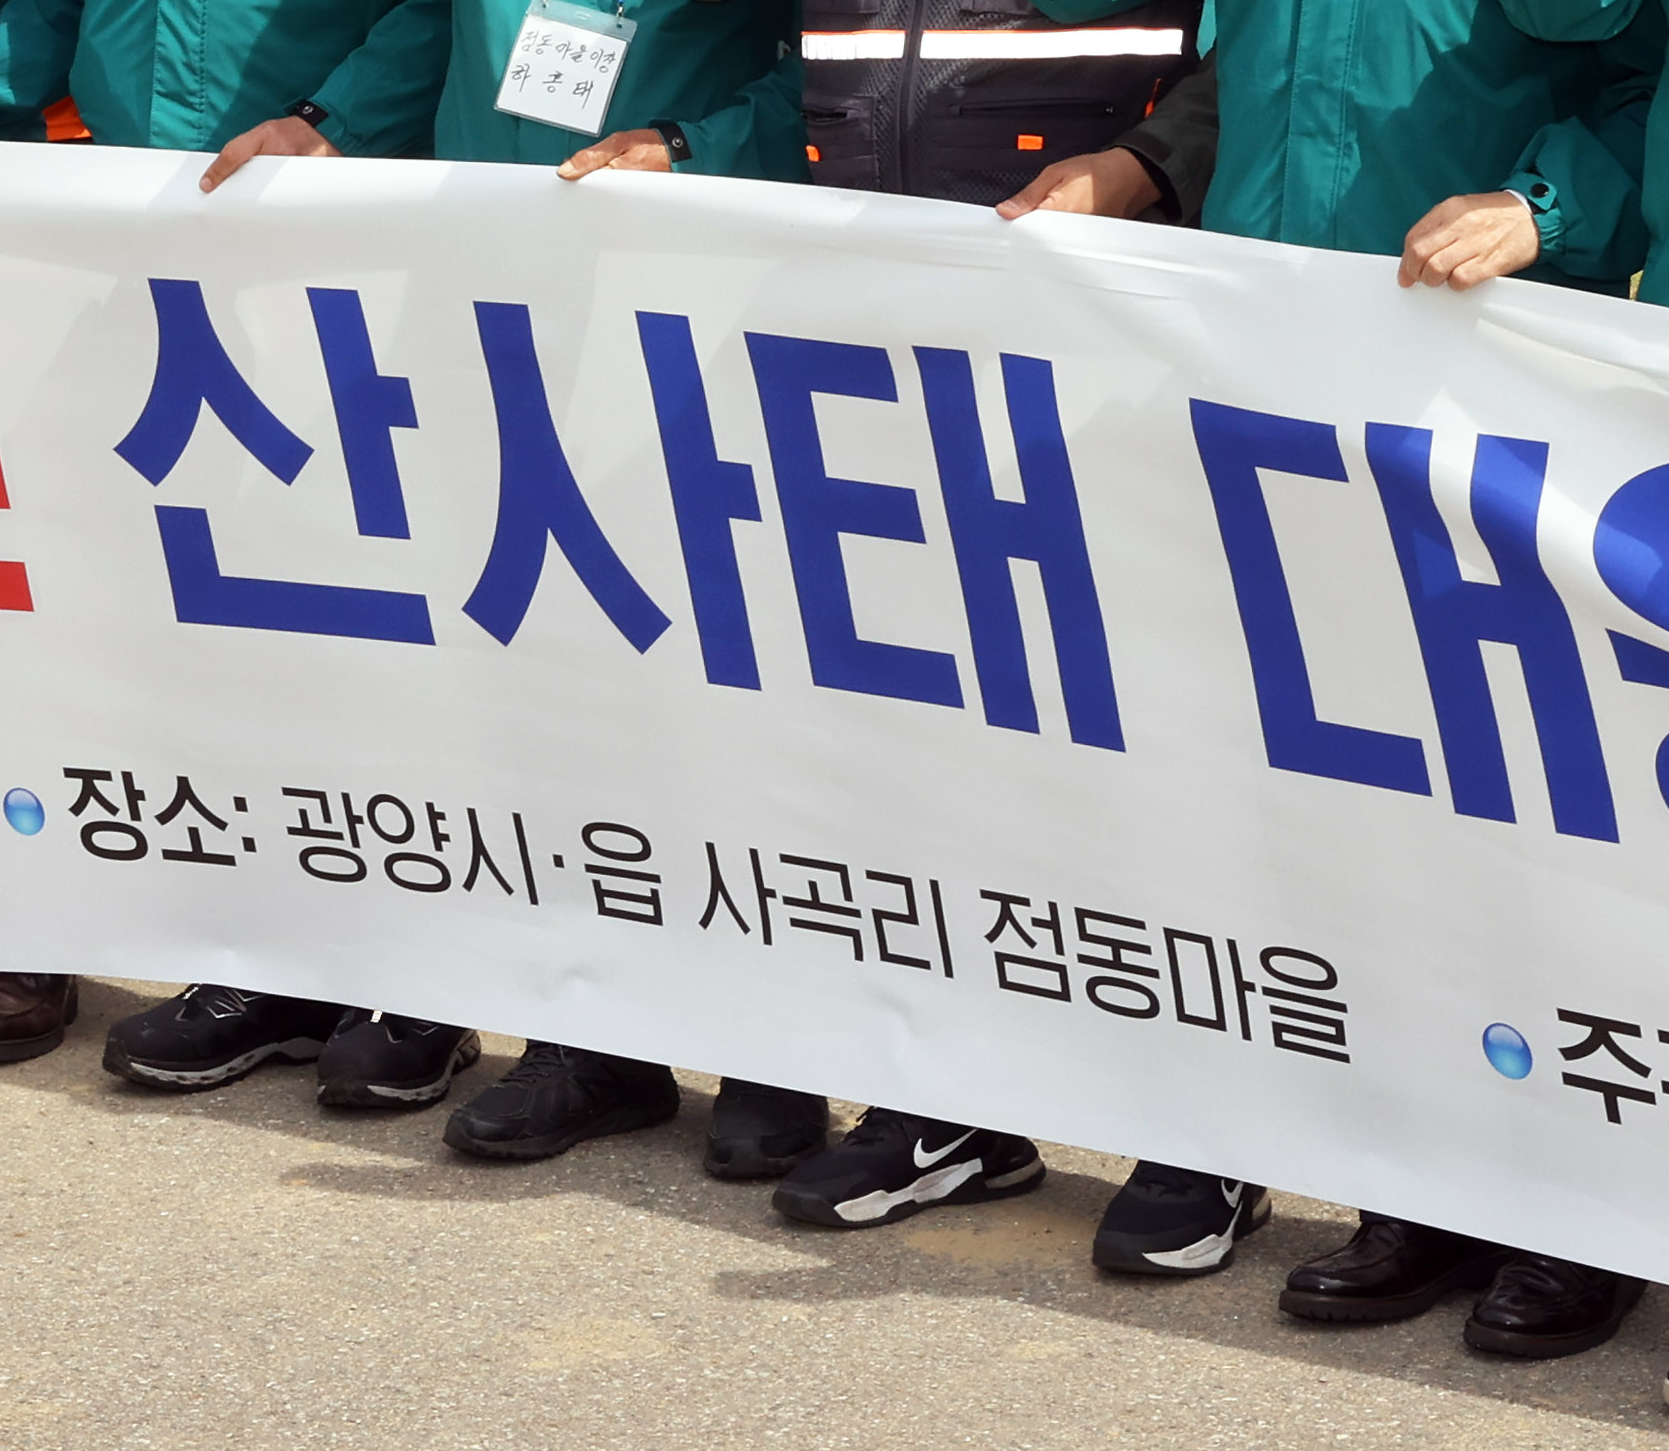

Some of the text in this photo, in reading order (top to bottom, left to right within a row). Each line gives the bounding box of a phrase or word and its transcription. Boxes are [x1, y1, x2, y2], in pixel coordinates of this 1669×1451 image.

[114, 277, 1126, 753] 산사태
[62, 766, 258, 868] 장소:
[697, 841, 955, 980] 사곡리
[978, 889, 1352, 1065] 점동마을
